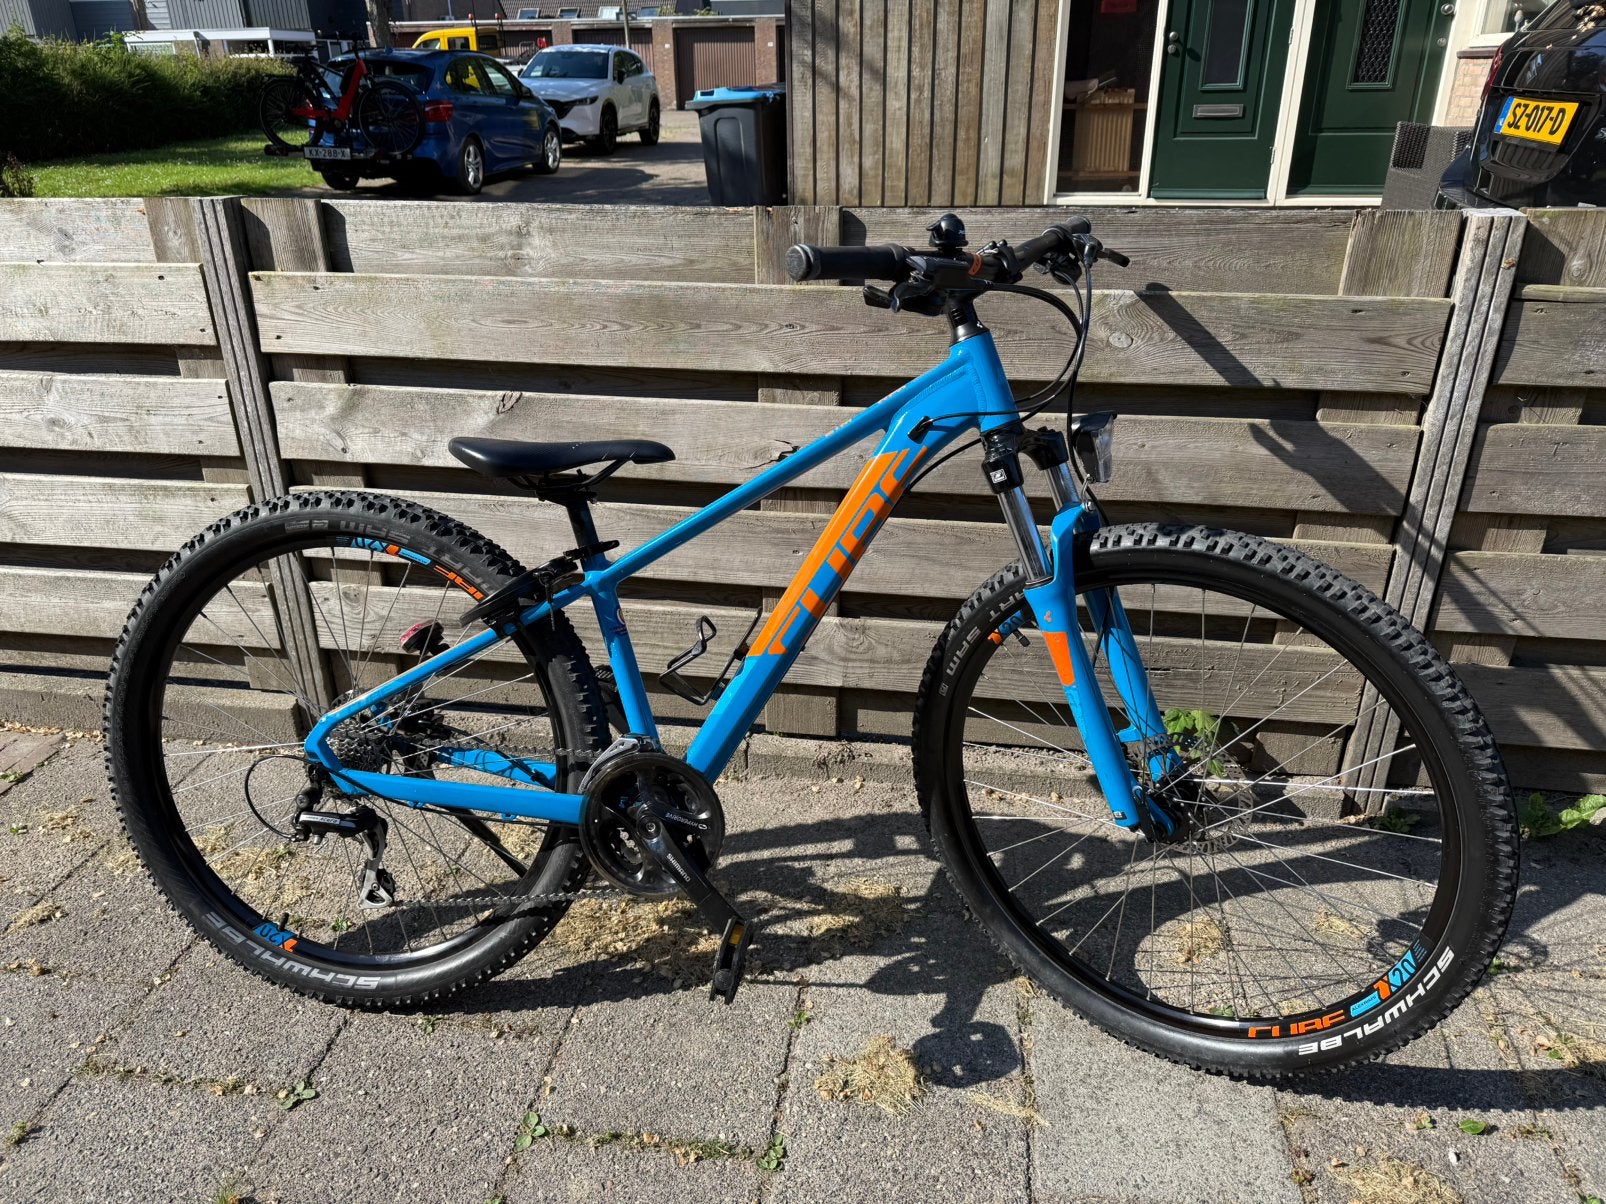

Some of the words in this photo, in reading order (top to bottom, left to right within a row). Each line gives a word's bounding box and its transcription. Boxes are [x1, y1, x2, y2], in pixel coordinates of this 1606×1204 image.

[1507, 102, 1566, 136] SZ-017-D
[946, 626, 981, 677] SAM
[666, 852, 691, 883] SHIMANO
[205, 911, 383, 990] SCHWALBE
[1298, 945, 1455, 1056] SCHWALBE
